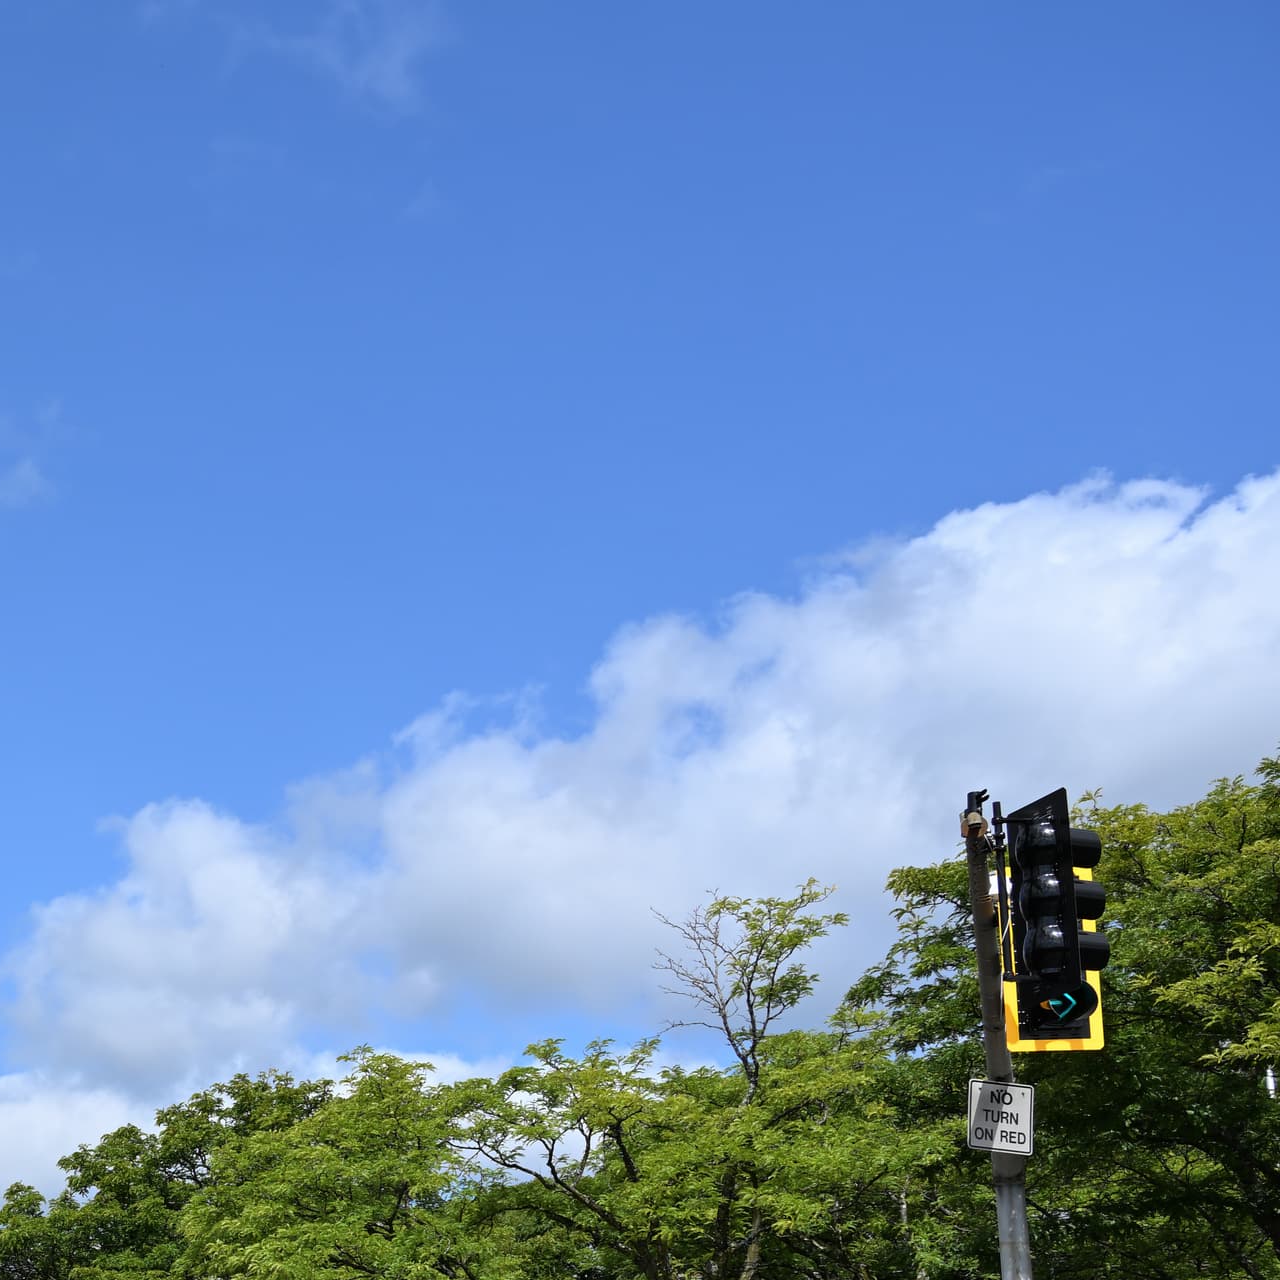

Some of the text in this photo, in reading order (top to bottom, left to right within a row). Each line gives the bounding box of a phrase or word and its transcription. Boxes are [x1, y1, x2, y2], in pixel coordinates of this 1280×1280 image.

[990, 1090, 1013, 1105] NO
[982, 1108, 1019, 1125] TURN
[974, 1127, 1026, 1145] ON RED
